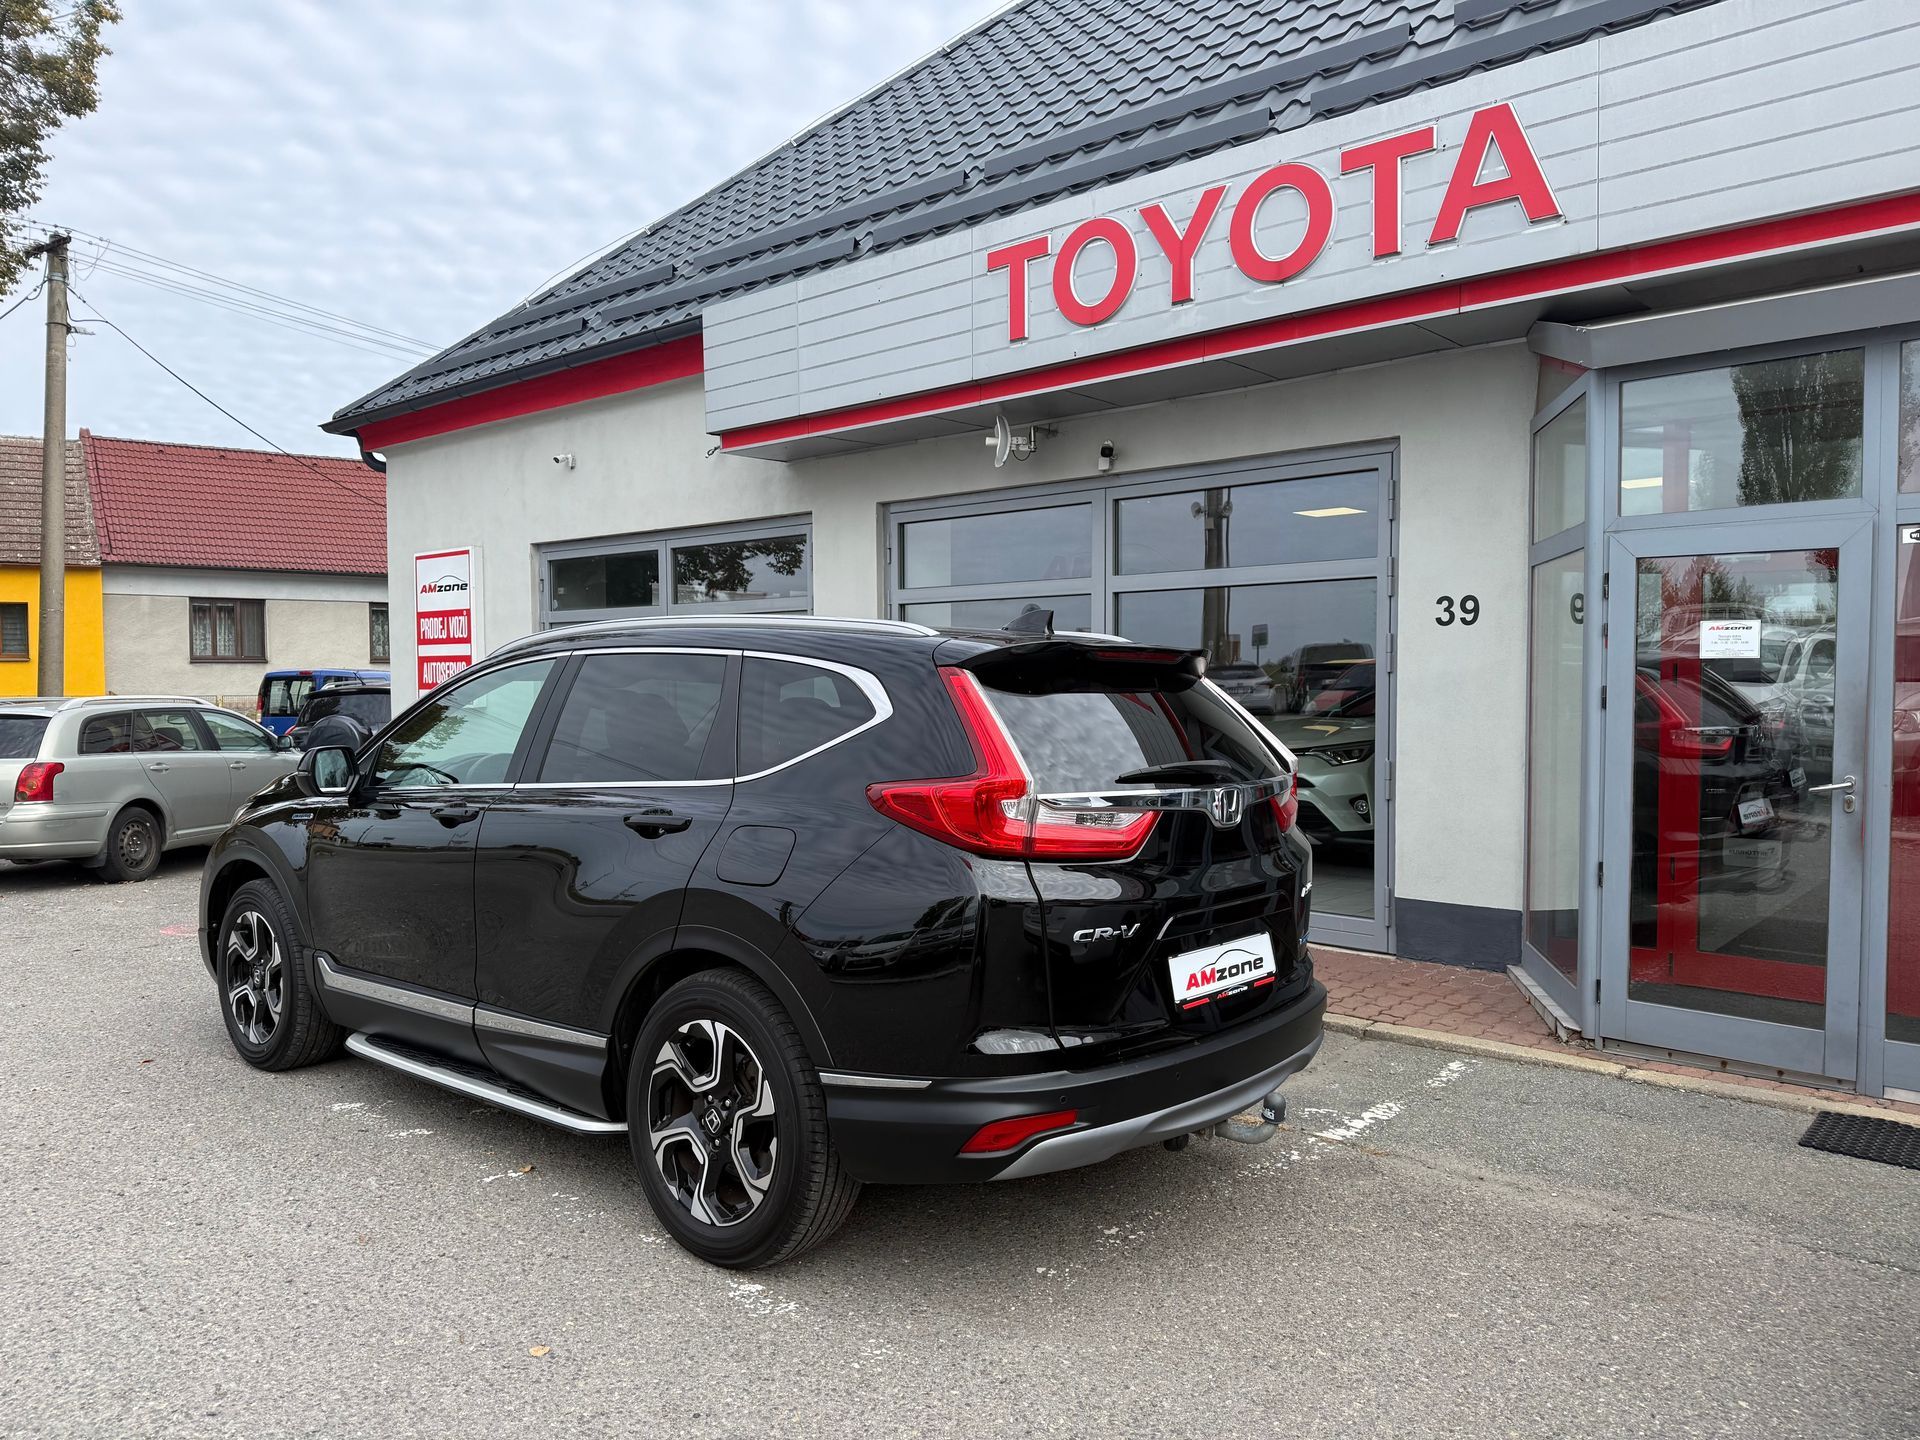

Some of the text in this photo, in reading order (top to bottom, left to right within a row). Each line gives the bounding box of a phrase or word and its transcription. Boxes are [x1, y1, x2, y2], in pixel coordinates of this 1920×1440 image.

[986, 101, 1565, 342] TOYOTA
[420, 583, 468, 594] AMzone
[420, 610, 468, 639] PRODEJ VOZŮ
[1435, 594, 1480, 626] 39
[1073, 923, 1141, 943] CR-V
[1185, 956, 1264, 991] AMzone
[1217, 985, 1248, 999] AMzone
